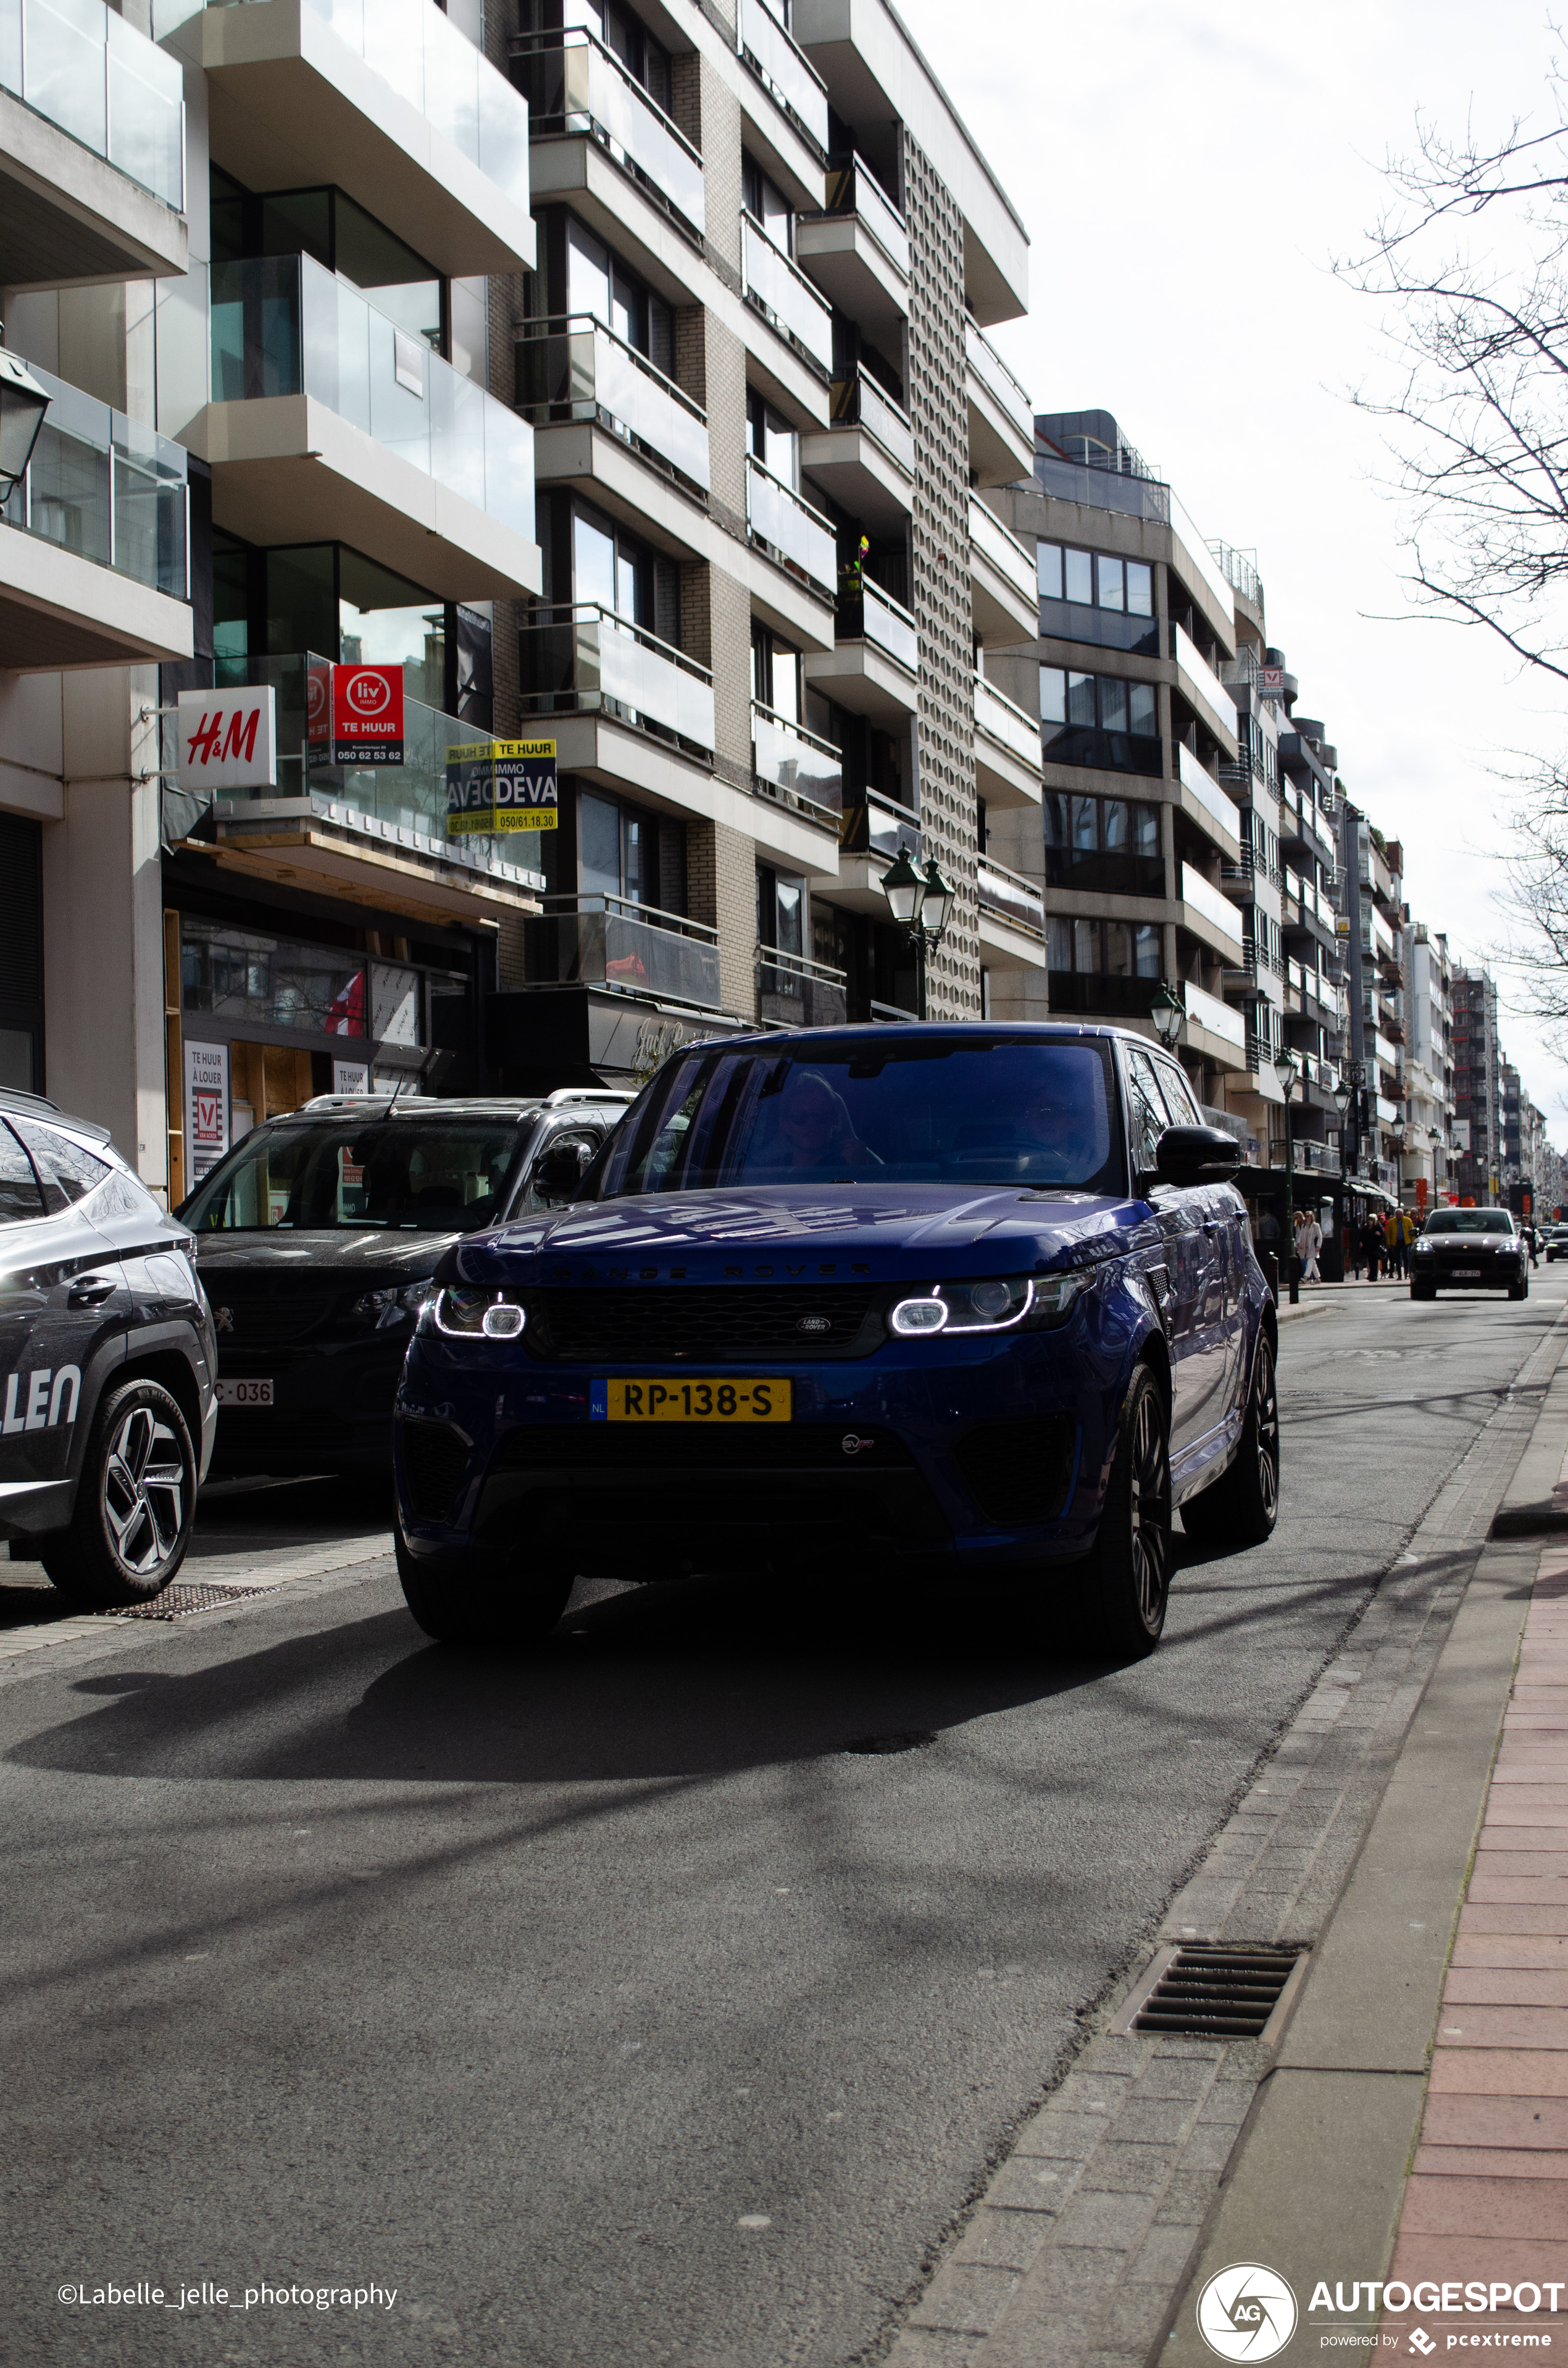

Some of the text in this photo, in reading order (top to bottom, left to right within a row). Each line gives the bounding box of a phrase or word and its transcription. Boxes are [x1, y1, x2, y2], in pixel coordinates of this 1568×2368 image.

[342, 722, 396, 732] TE HUUR
[187, 708, 261, 766] H&M
[338, 751, 401, 759] 050 62 53 62
[499, 743, 551, 754] TE HUUR
[495, 763, 524, 774] IMMO
[495, 776, 557, 803] DEVA
[500, 816, 553, 827] 050/61.18.30
[192, 1051, 222, 1066] TE HUUR
[199, 1070, 222, 1084] LOUER
[340, 1070, 347, 1081] TE
[348, 1071, 364, 1083] HUUR
[553, 1263, 871, 1280] RANGE ROVER
[625, 1384, 772, 1415] RP-138-S
[592, 1404, 605, 1413] NL
